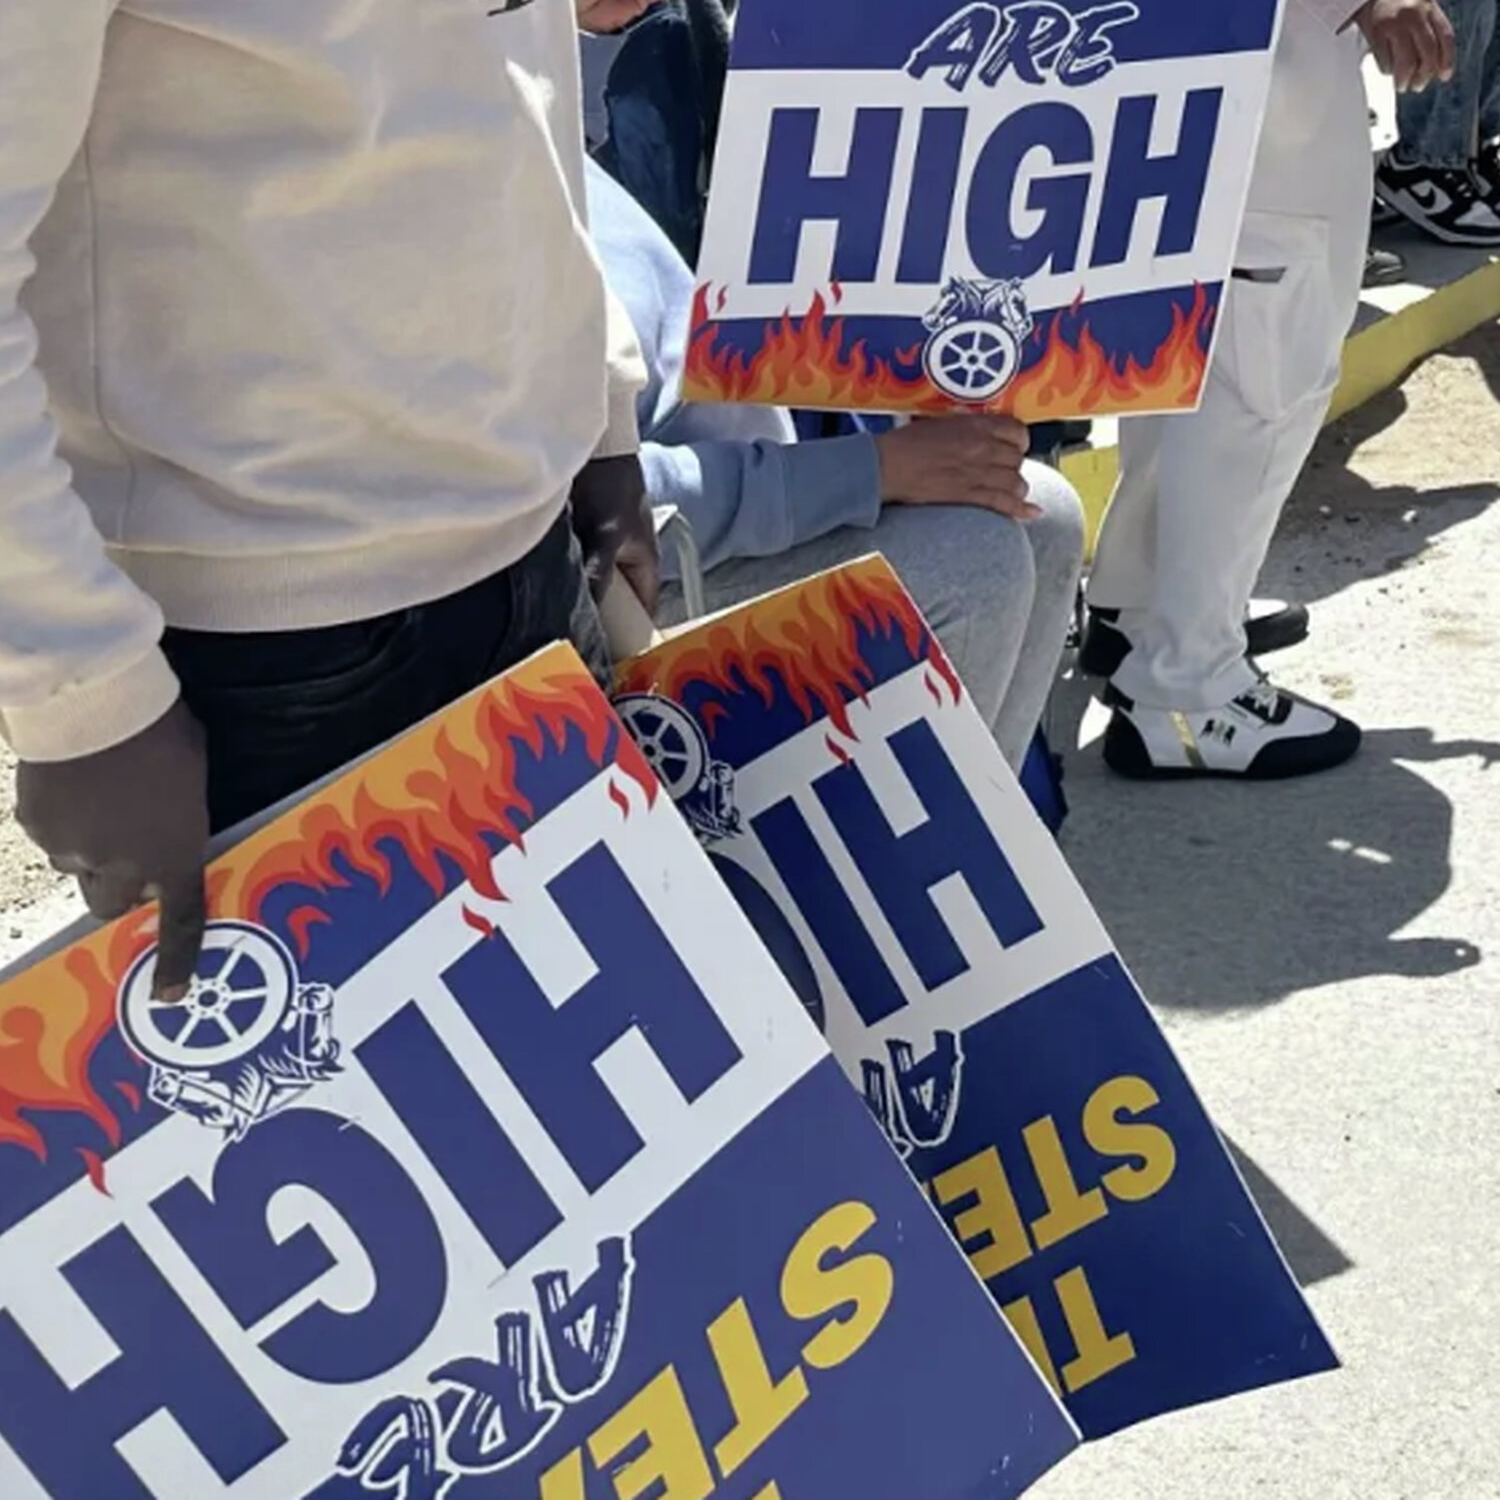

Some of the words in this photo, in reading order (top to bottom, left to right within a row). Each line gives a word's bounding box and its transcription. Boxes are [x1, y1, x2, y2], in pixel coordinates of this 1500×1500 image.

[903, 0, 1139, 92] ARE
[746, 86, 1225, 284] HIGH
[706, 716, 1045, 1035] HI
[0, 841, 744, 1500] HIGH
[922, 1075, 1177, 1260] STE
[336, 1235, 636, 1500] ARE
[538, 1200, 894, 1500] STE
